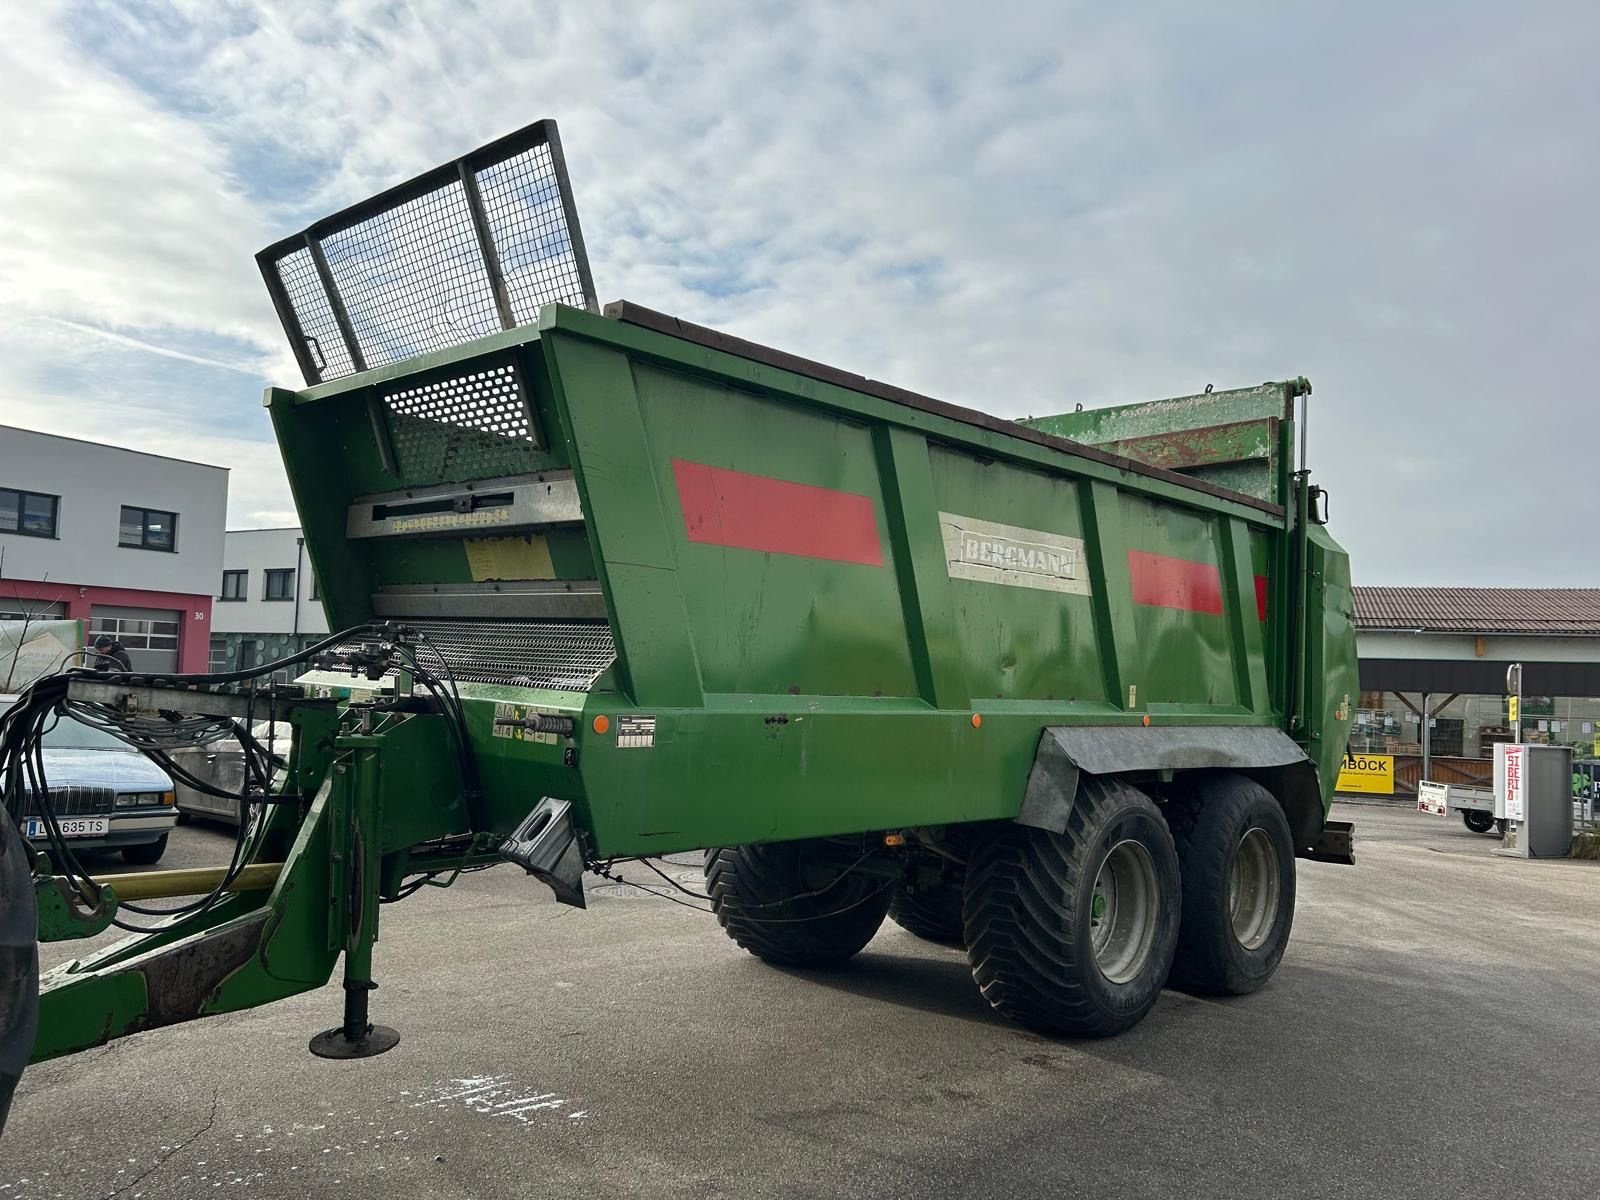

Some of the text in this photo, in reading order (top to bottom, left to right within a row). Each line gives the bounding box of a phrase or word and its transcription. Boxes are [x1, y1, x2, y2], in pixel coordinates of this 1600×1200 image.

[965, 539, 1072, 574] BERGMANN
[194, 611, 204, 620] 30
[62, 821, 85, 833] 635
[89, 820, 103, 832] TS
